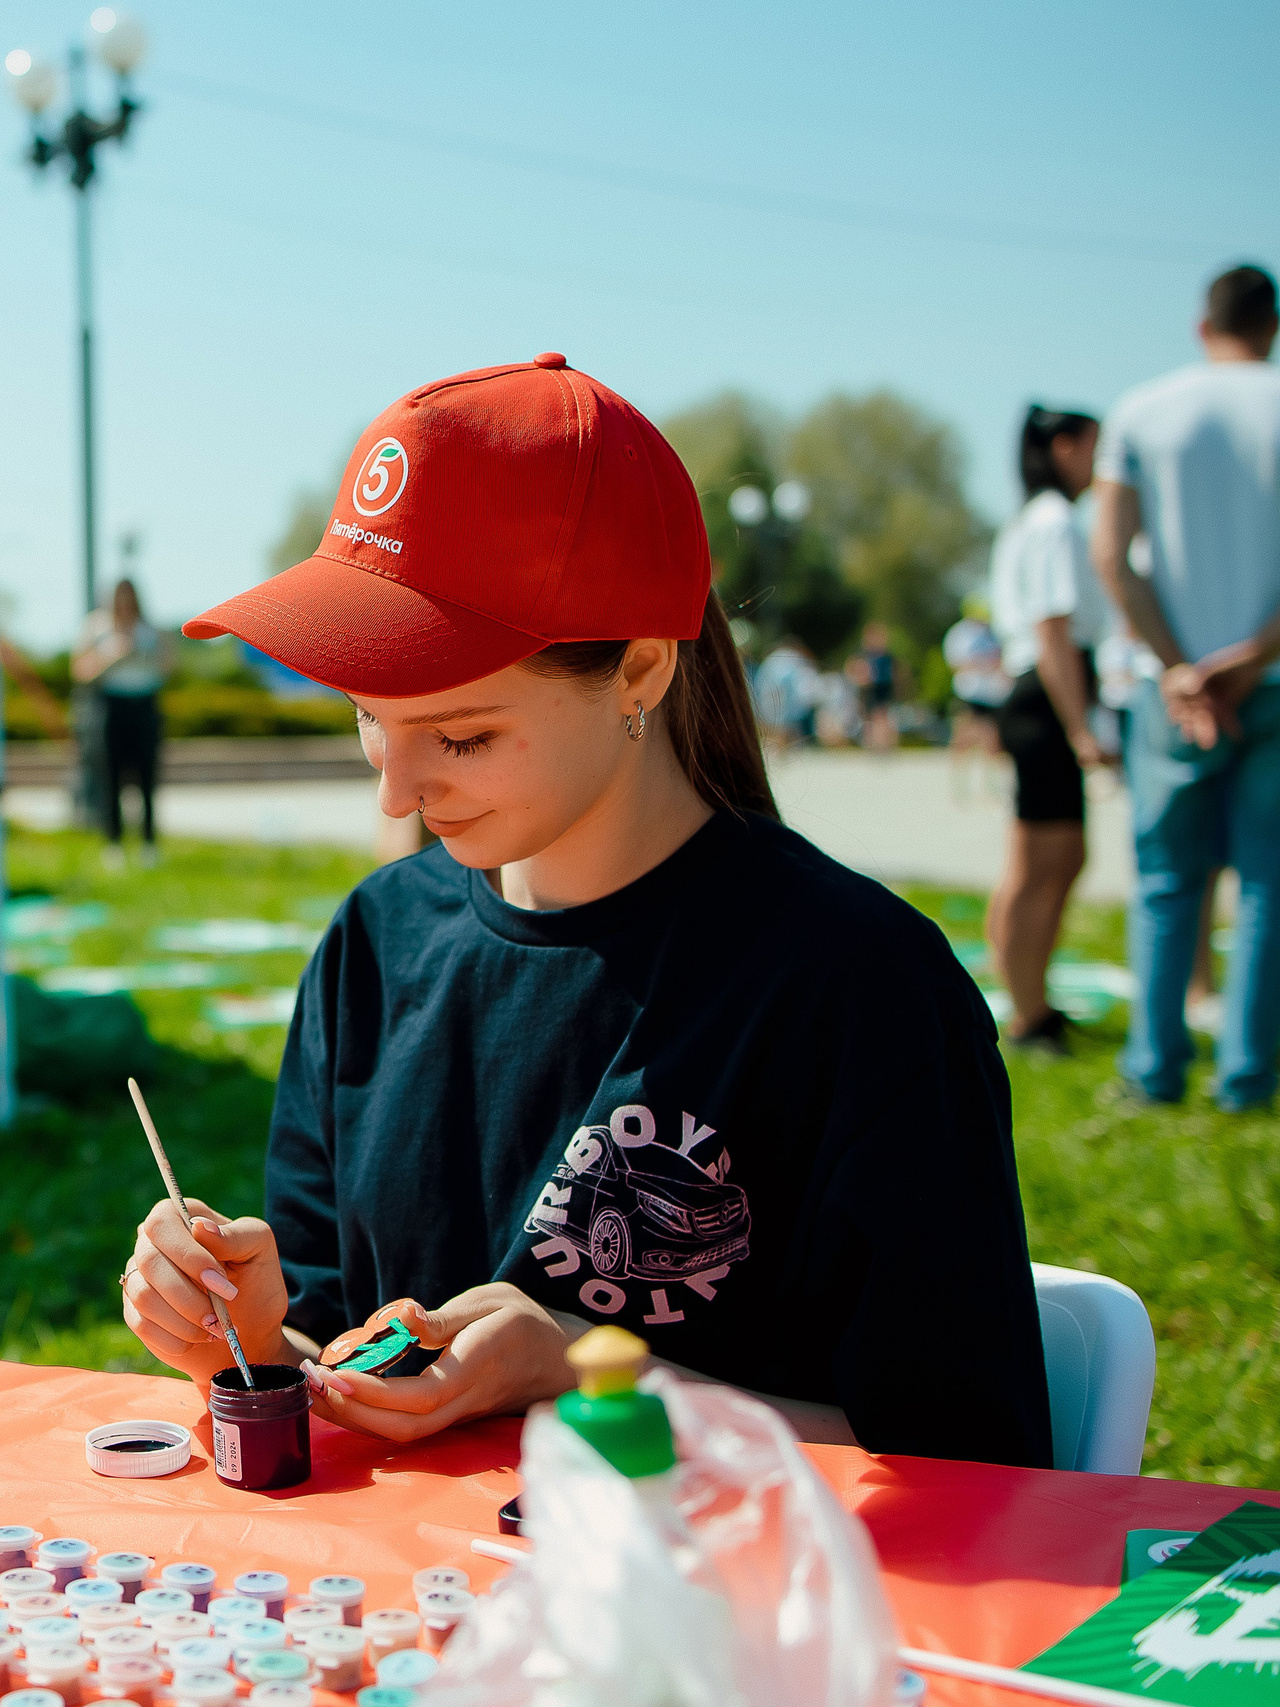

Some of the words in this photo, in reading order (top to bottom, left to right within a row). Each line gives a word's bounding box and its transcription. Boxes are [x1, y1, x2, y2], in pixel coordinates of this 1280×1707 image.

[362, 445, 400, 501] 5
[329, 518, 404, 554] Пятёрочка
[231, 1463, 238, 1473] 09
